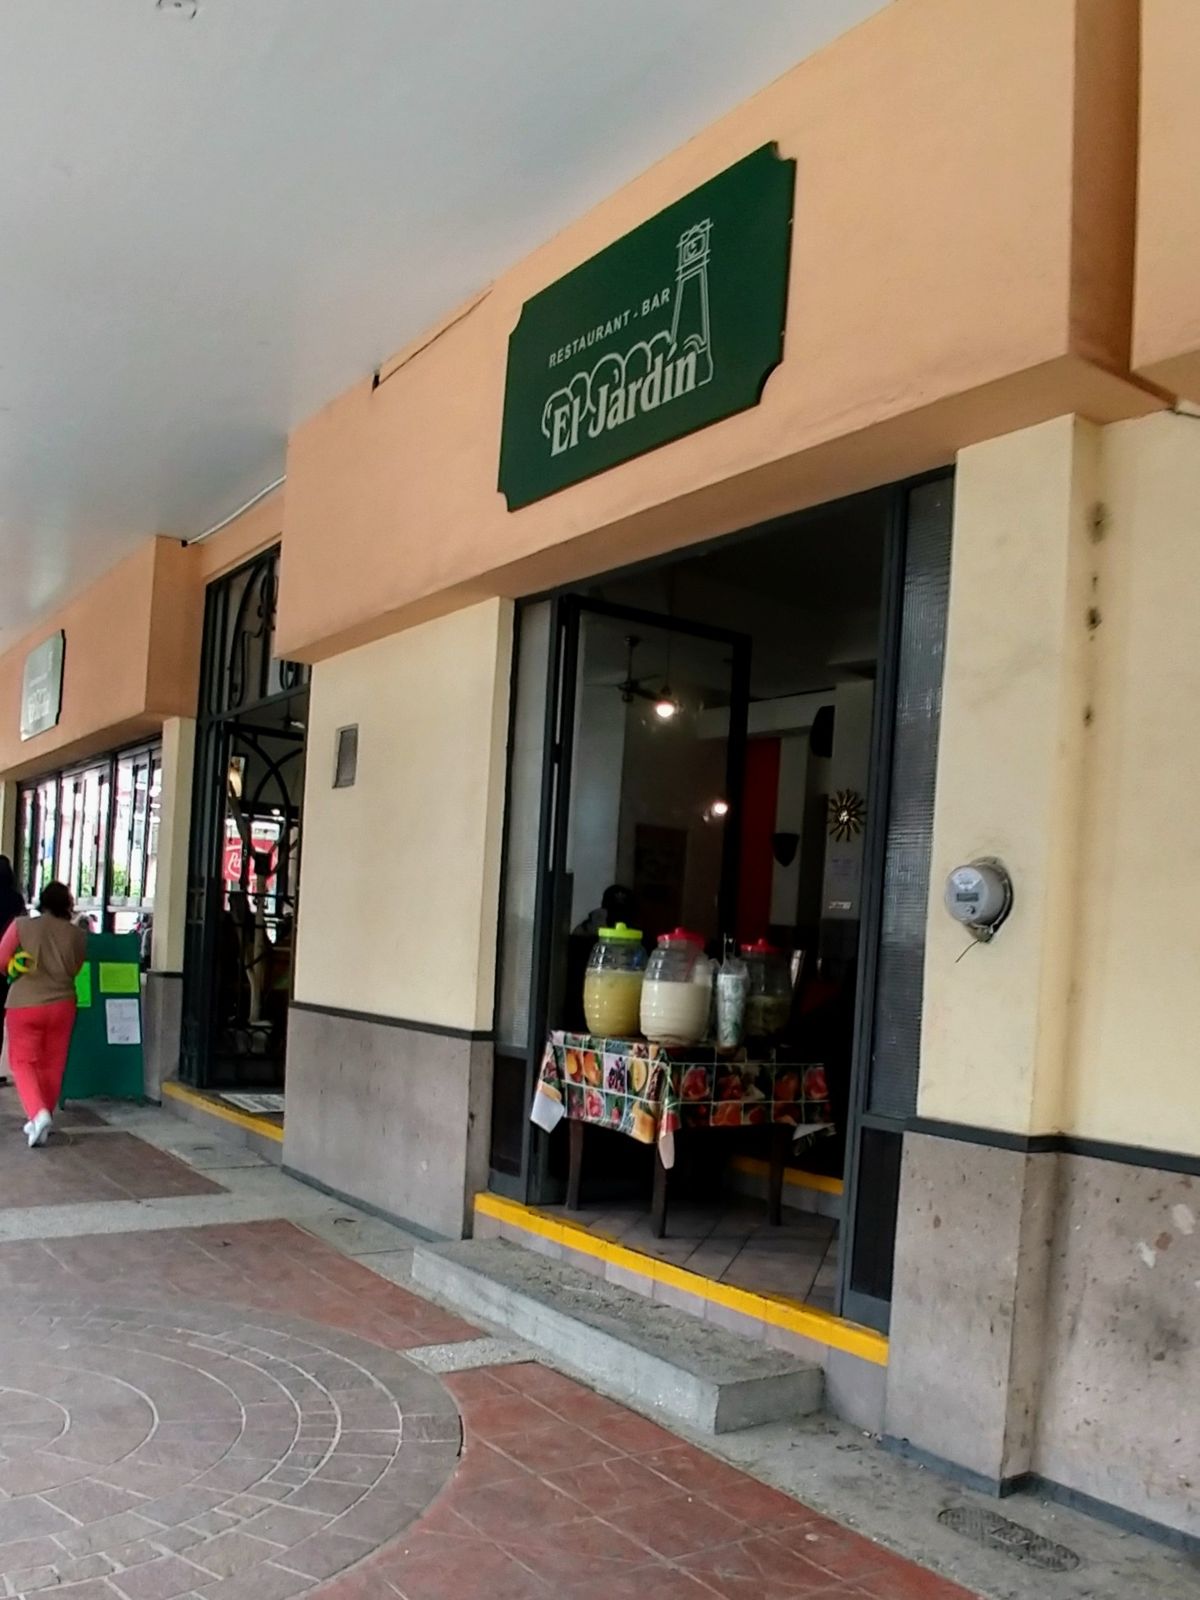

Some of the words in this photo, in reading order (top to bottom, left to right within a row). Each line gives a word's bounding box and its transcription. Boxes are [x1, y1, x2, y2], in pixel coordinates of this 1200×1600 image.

[549, 309, 631, 368] RESTAURANT
[642, 287, 671, 317] BAR
[550, 395, 581, 457] El
[588, 342, 698, 439] Jardín
